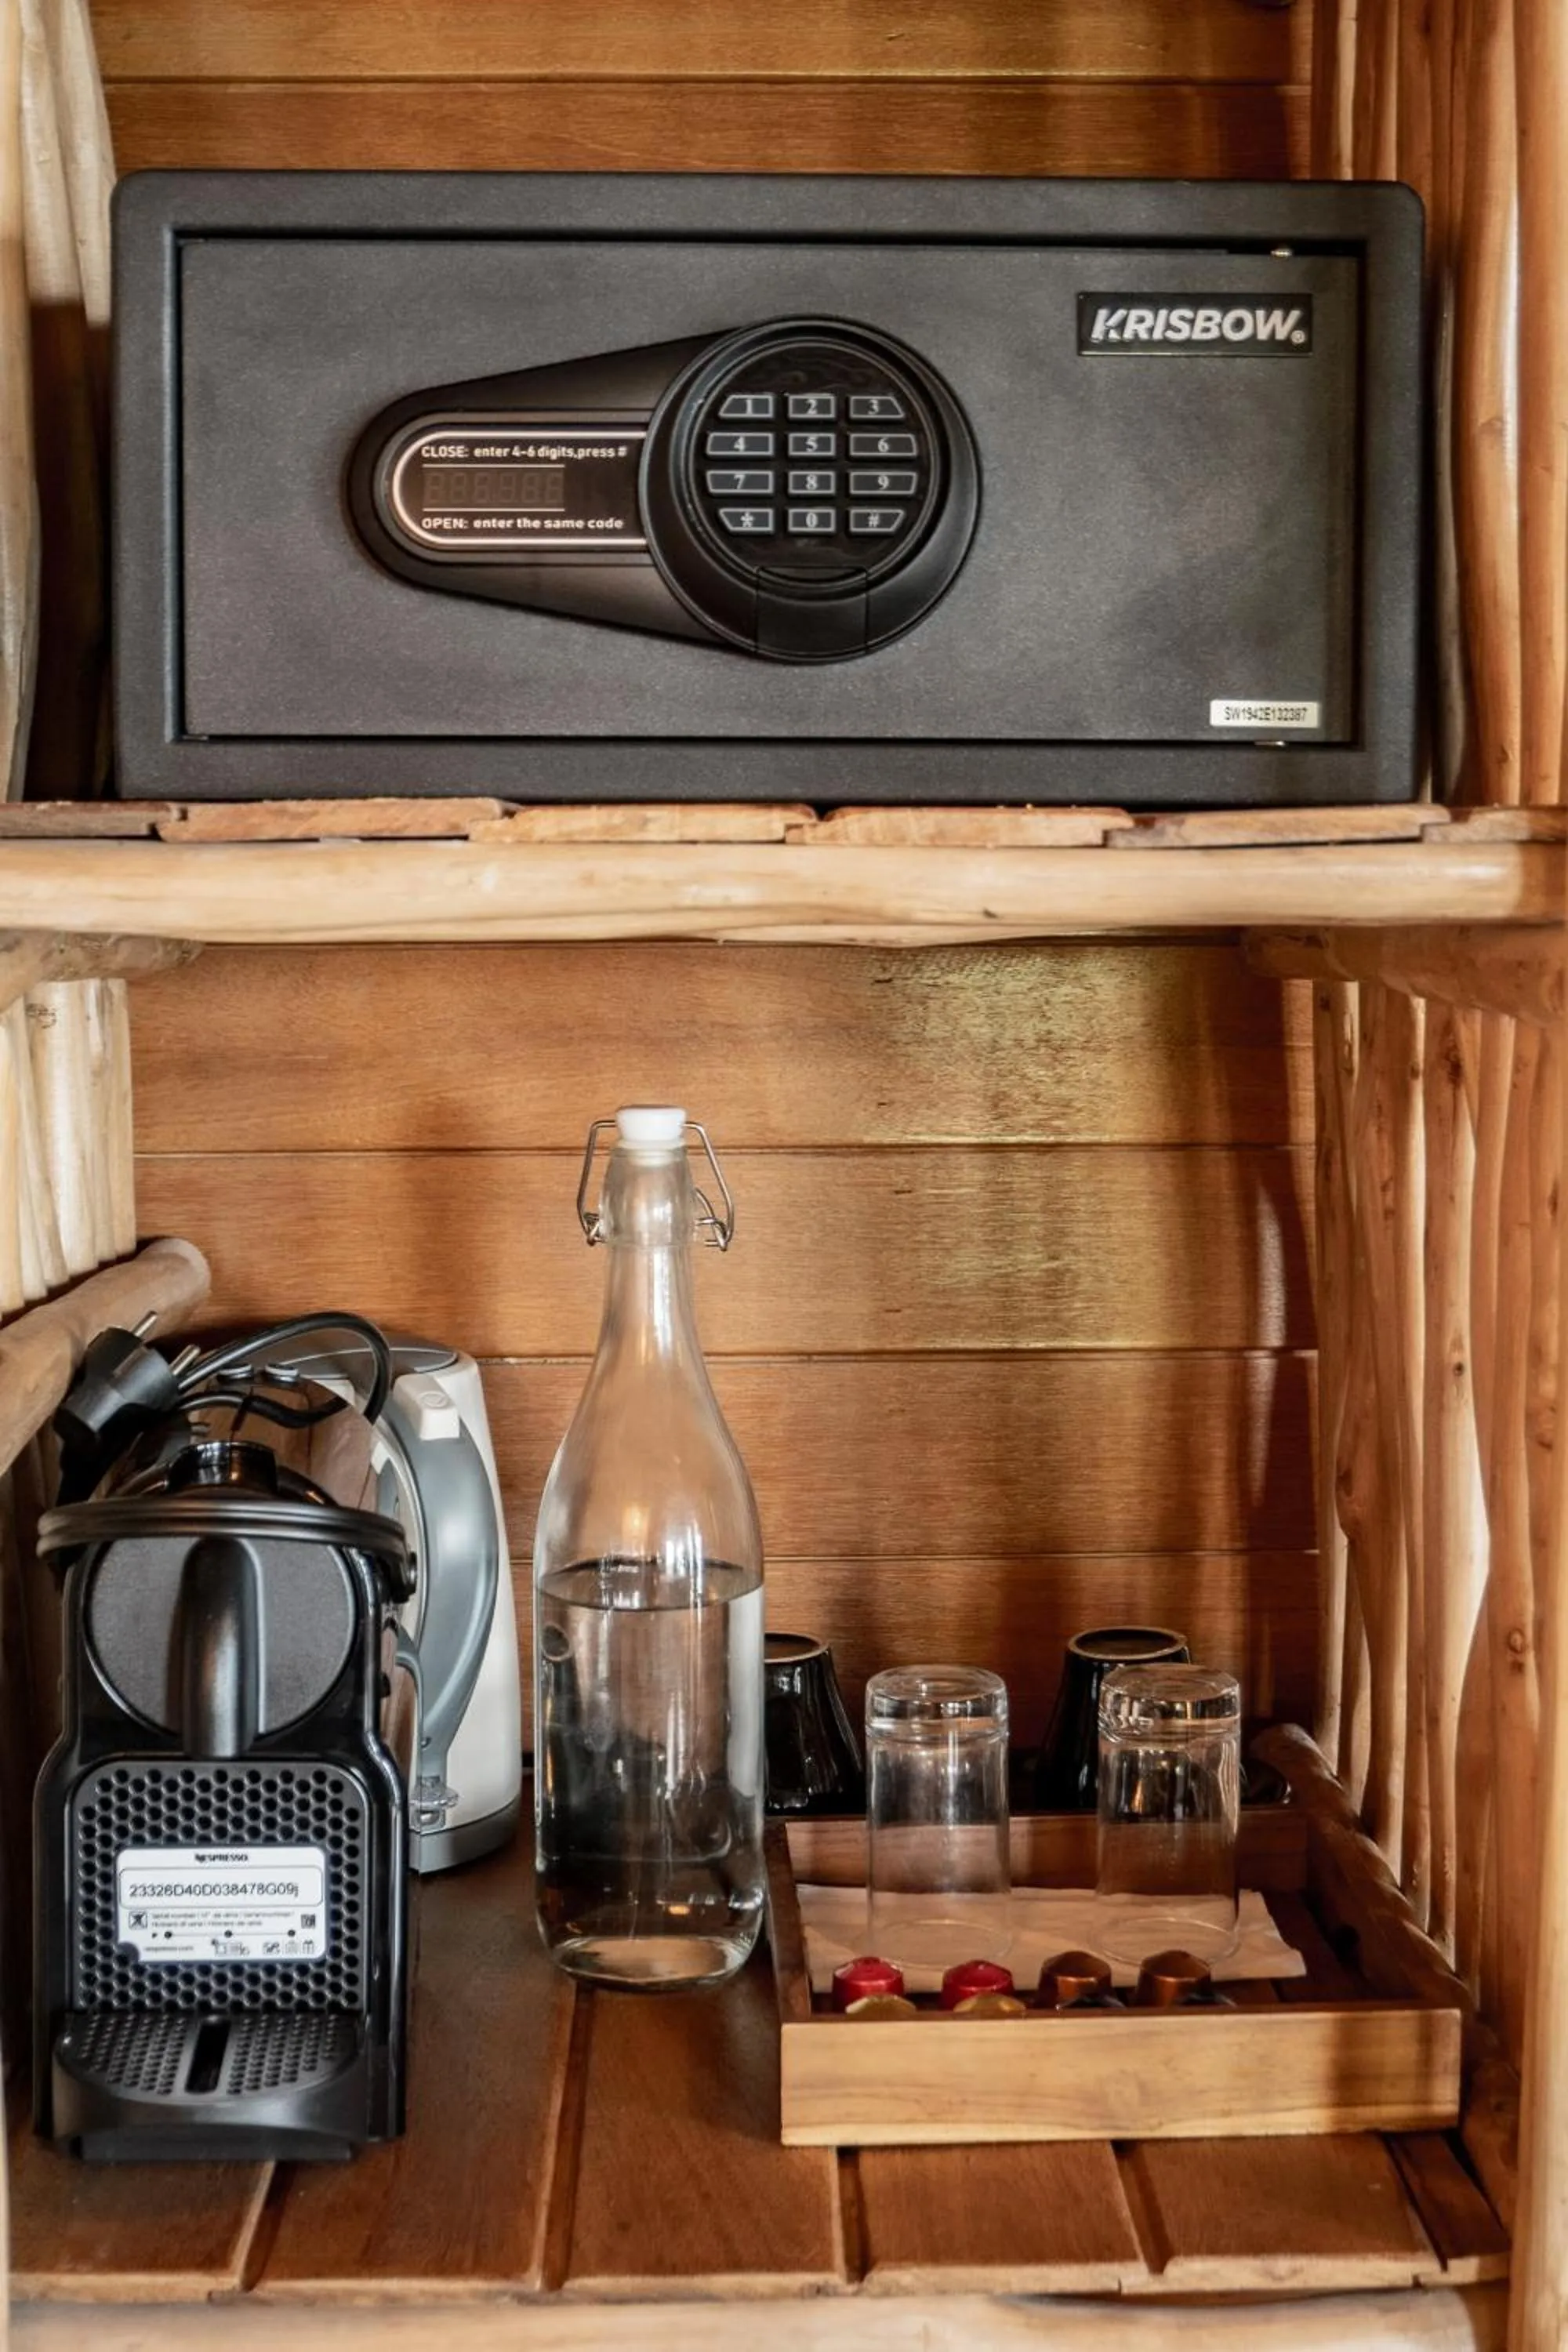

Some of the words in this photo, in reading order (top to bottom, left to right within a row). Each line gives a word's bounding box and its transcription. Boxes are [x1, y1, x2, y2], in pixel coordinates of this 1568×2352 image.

[746, 398, 753, 416] 1
[806, 398, 817, 416] 2
[868, 398, 879, 415] 3
[421, 445, 469, 457] CLOSE:
[474, 446, 509, 457] enter
[511, 445, 535, 457] 4-6
[618, 445, 627, 456] #
[733, 437, 745, 452] 4
[805, 437, 817, 452] 5
[877, 437, 889, 452] 6
[733, 474, 745, 489] 7
[805, 474, 817, 489] 8
[877, 475, 889, 489] 9
[422, 517, 468, 529] OPEN:
[473, 518, 513, 529] enter
[517, 517, 541, 529] the
[543, 520, 585, 529] same
[587, 517, 624, 529] code
[805, 512, 817, 528] 0
[868, 513, 880, 527] #
